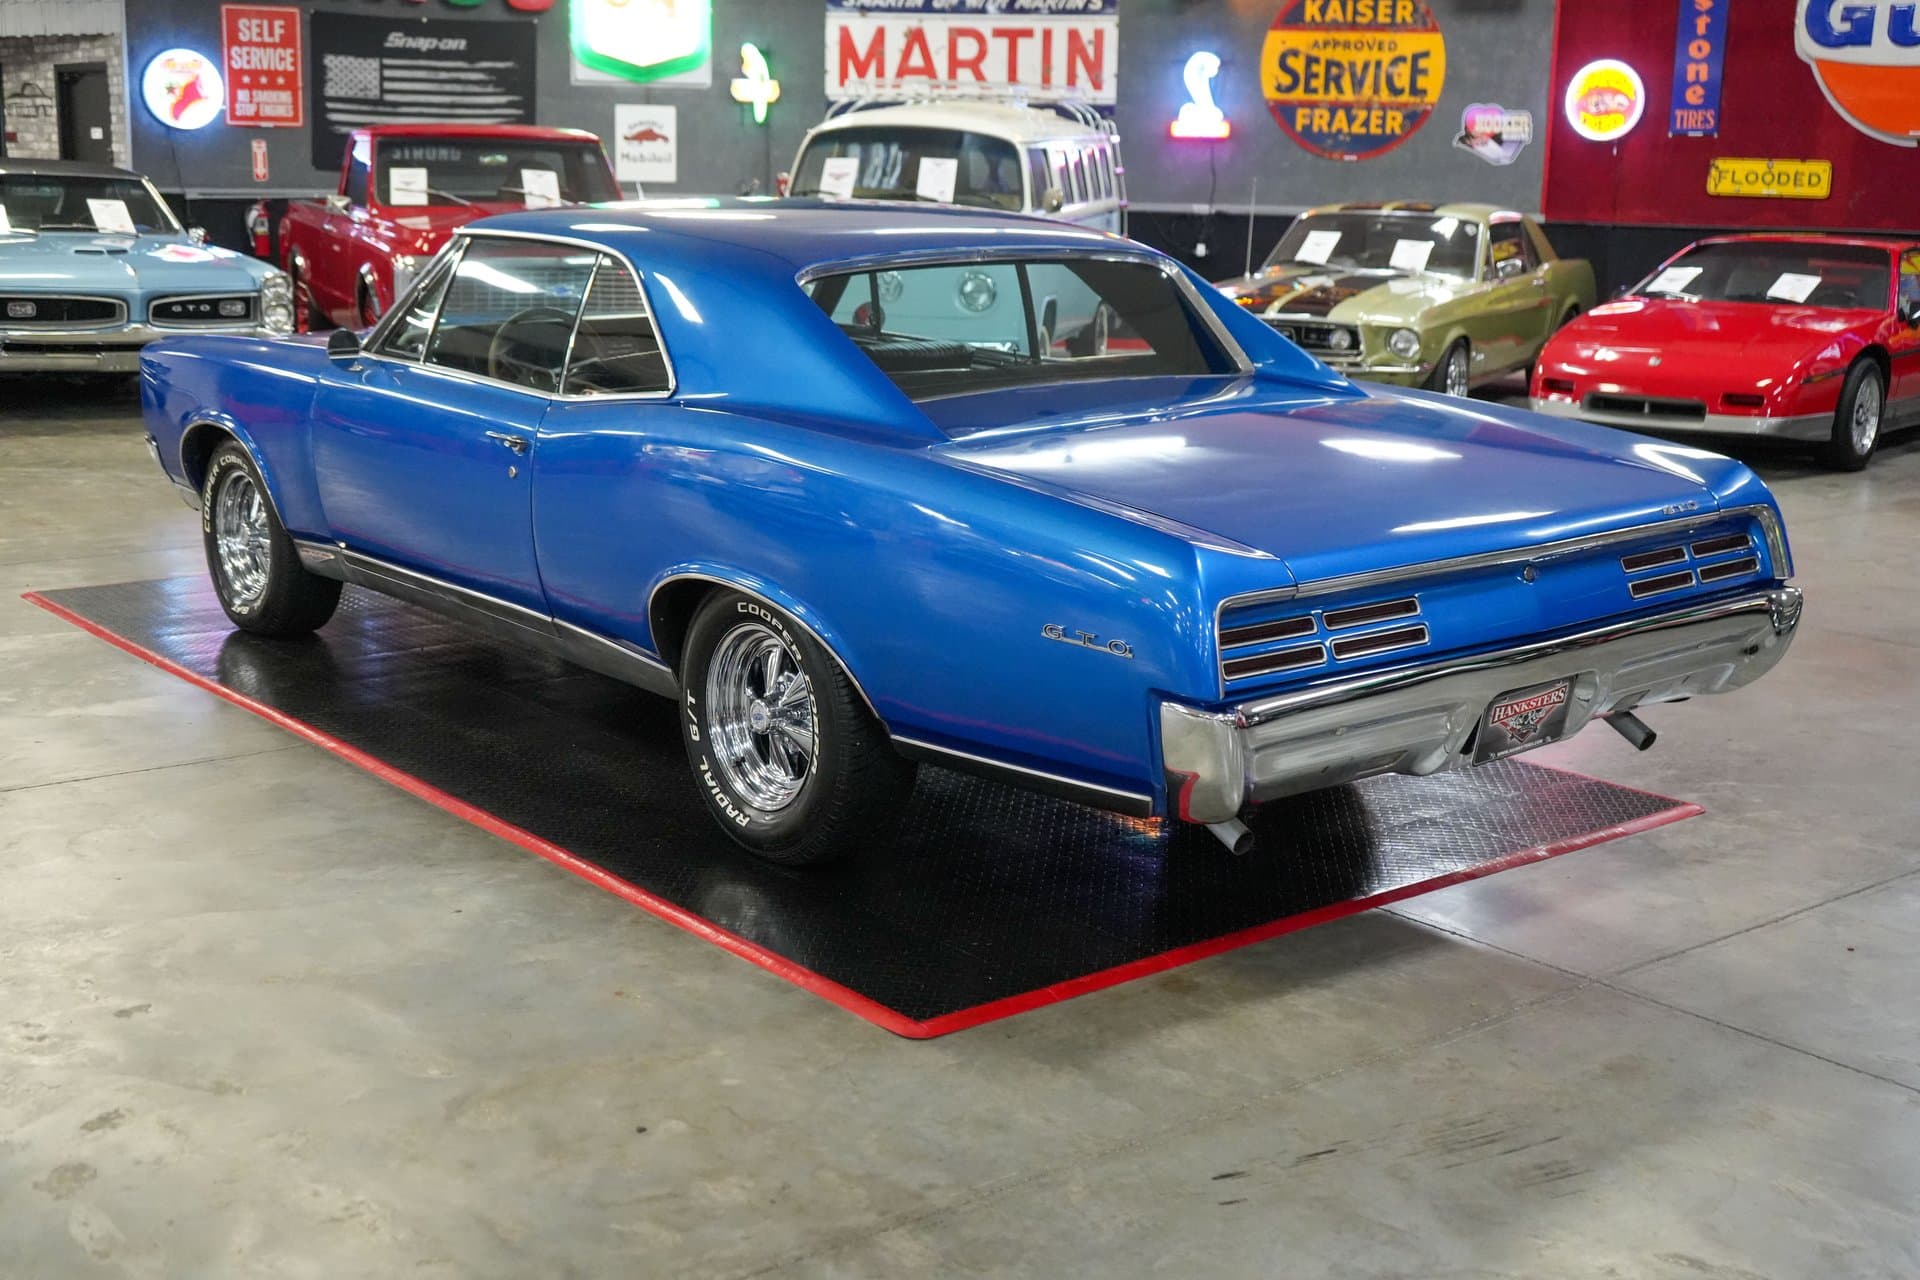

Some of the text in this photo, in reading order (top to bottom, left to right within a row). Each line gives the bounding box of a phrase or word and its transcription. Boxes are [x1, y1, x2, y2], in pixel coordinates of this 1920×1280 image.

[1303, 0, 1414, 24] KAISER
[237, 18, 285, 43] SELF
[383, 31, 467, 52] Snap-on
[839, 25, 1104, 91] MARTIN
[1311, 39, 1398, 51] APPROVED
[230, 46, 295, 71] SERVICE
[1274, 48, 1430, 97] SERVICE
[1295, 107, 1404, 135] FRAZER
[1675, 109, 1715, 129] TIRES
[1717, 170, 1821, 188] FLOODED
[172, 304, 210, 312] GTO
[203, 464, 219, 533] COOPER
[737, 602, 802, 661] COOPER
[1041, 623, 1134, 659] GTO
[1493, 687, 1566, 723] HANKSTERS
[687, 689, 750, 827] RADIAL G/T
